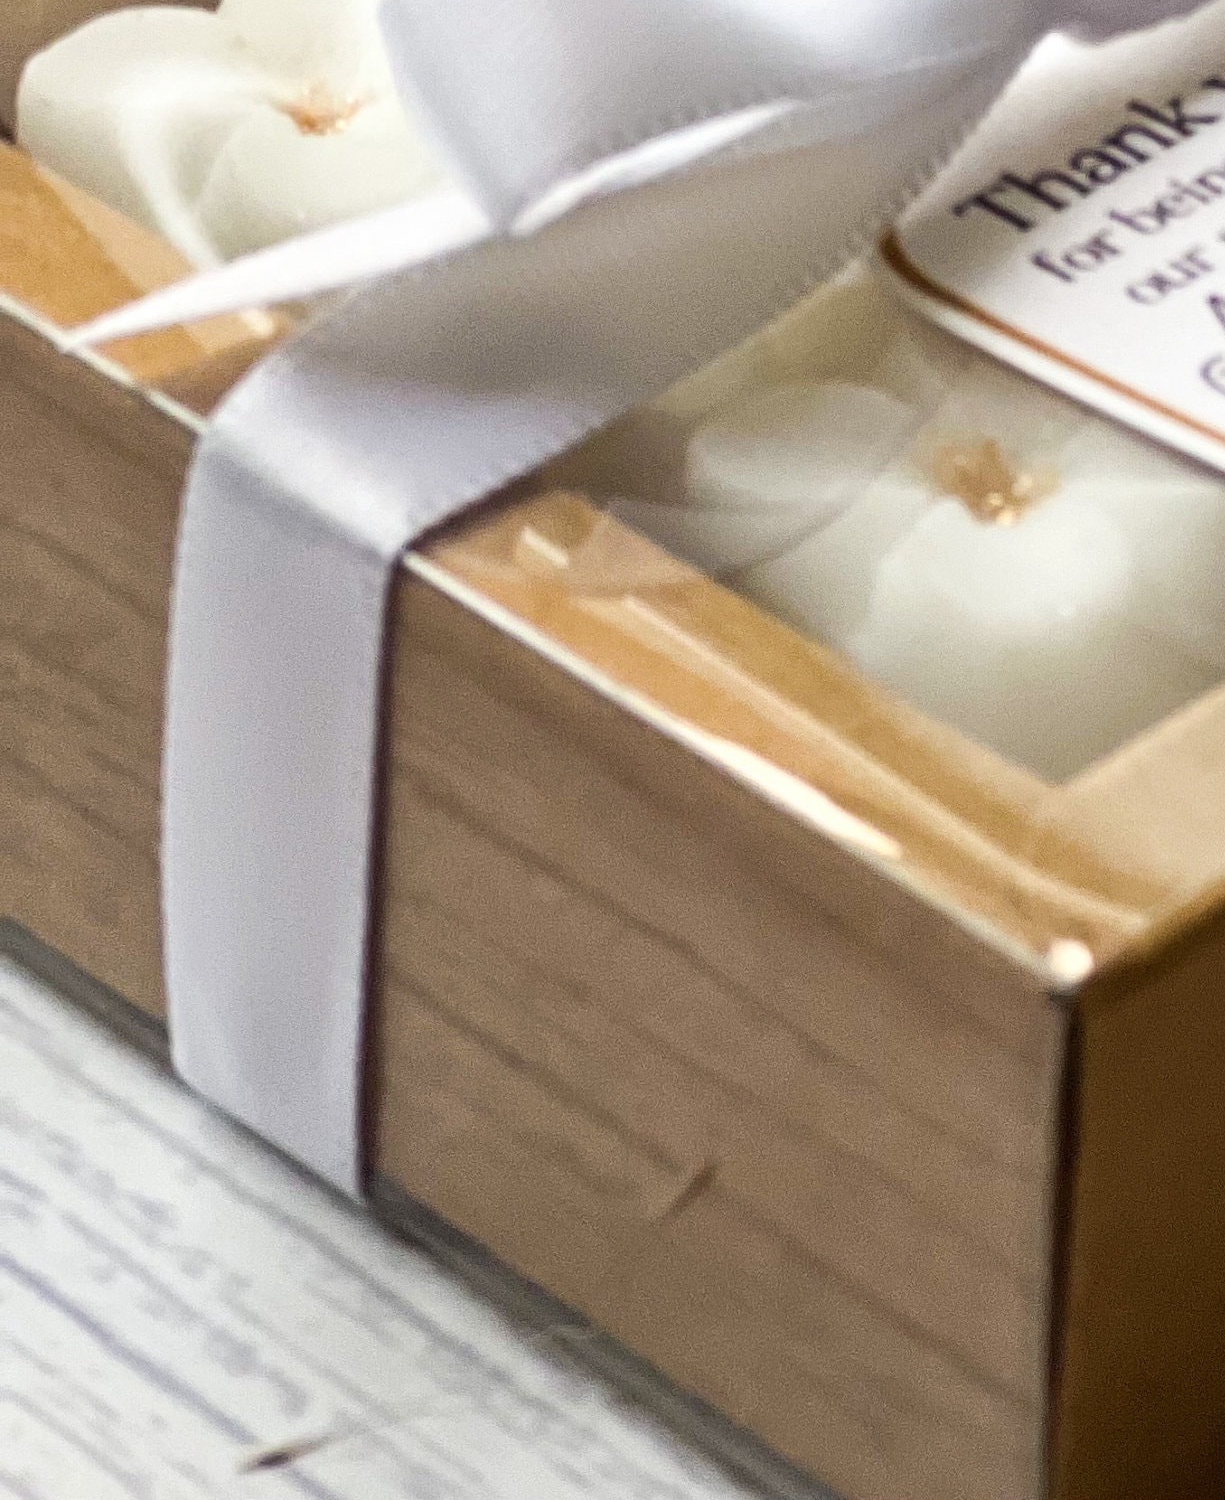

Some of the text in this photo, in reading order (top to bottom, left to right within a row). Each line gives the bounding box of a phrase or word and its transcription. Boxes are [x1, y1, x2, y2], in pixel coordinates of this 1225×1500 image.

[951, 96, 1221, 233] Thank
[1030, 230, 1121, 283] for
[1125, 245, 1215, 304] our
